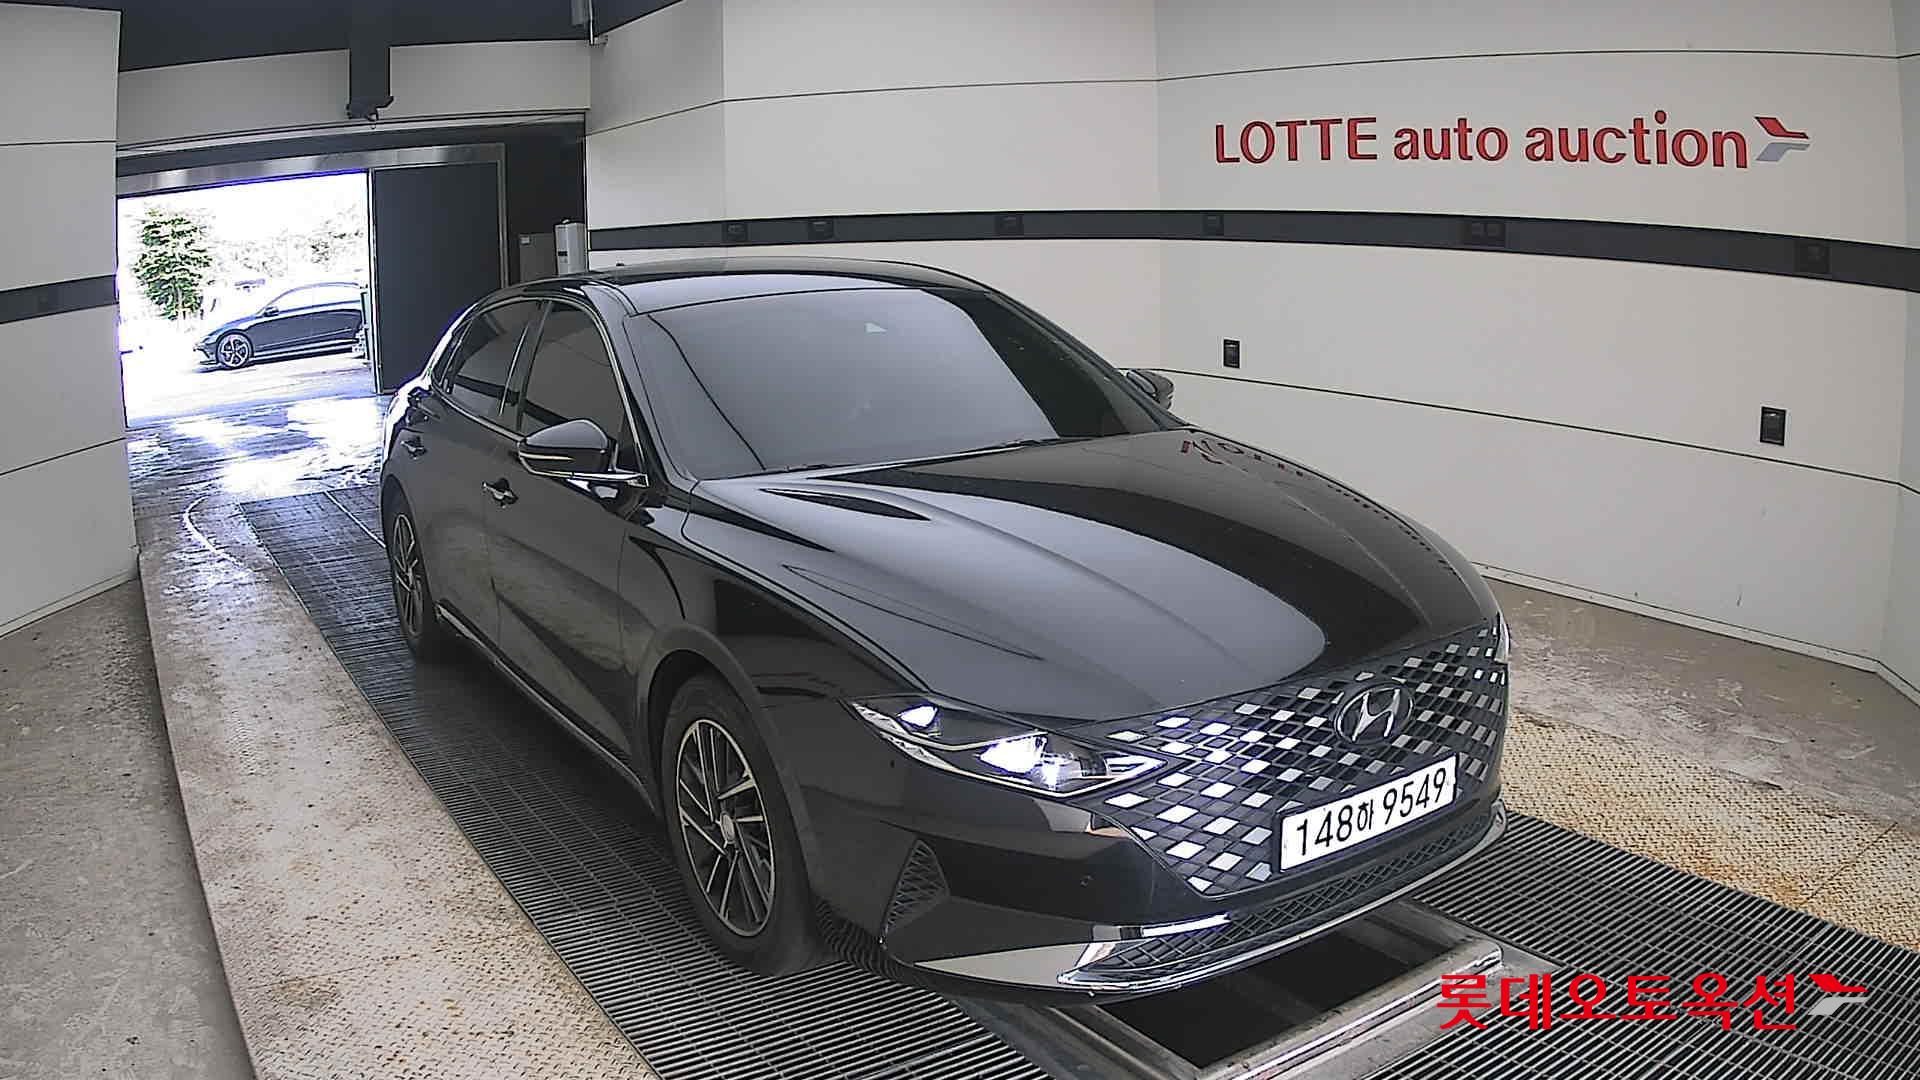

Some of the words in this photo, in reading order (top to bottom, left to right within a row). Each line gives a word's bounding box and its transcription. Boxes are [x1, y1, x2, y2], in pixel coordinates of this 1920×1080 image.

[1215, 117, 1377, 164] LOTTE
[1393, 118, 1508, 161] auto
[1525, 110, 1748, 169] auction
[1296, 798, 1375, 856] 148하
[1383, 767, 1447, 825] 9549
